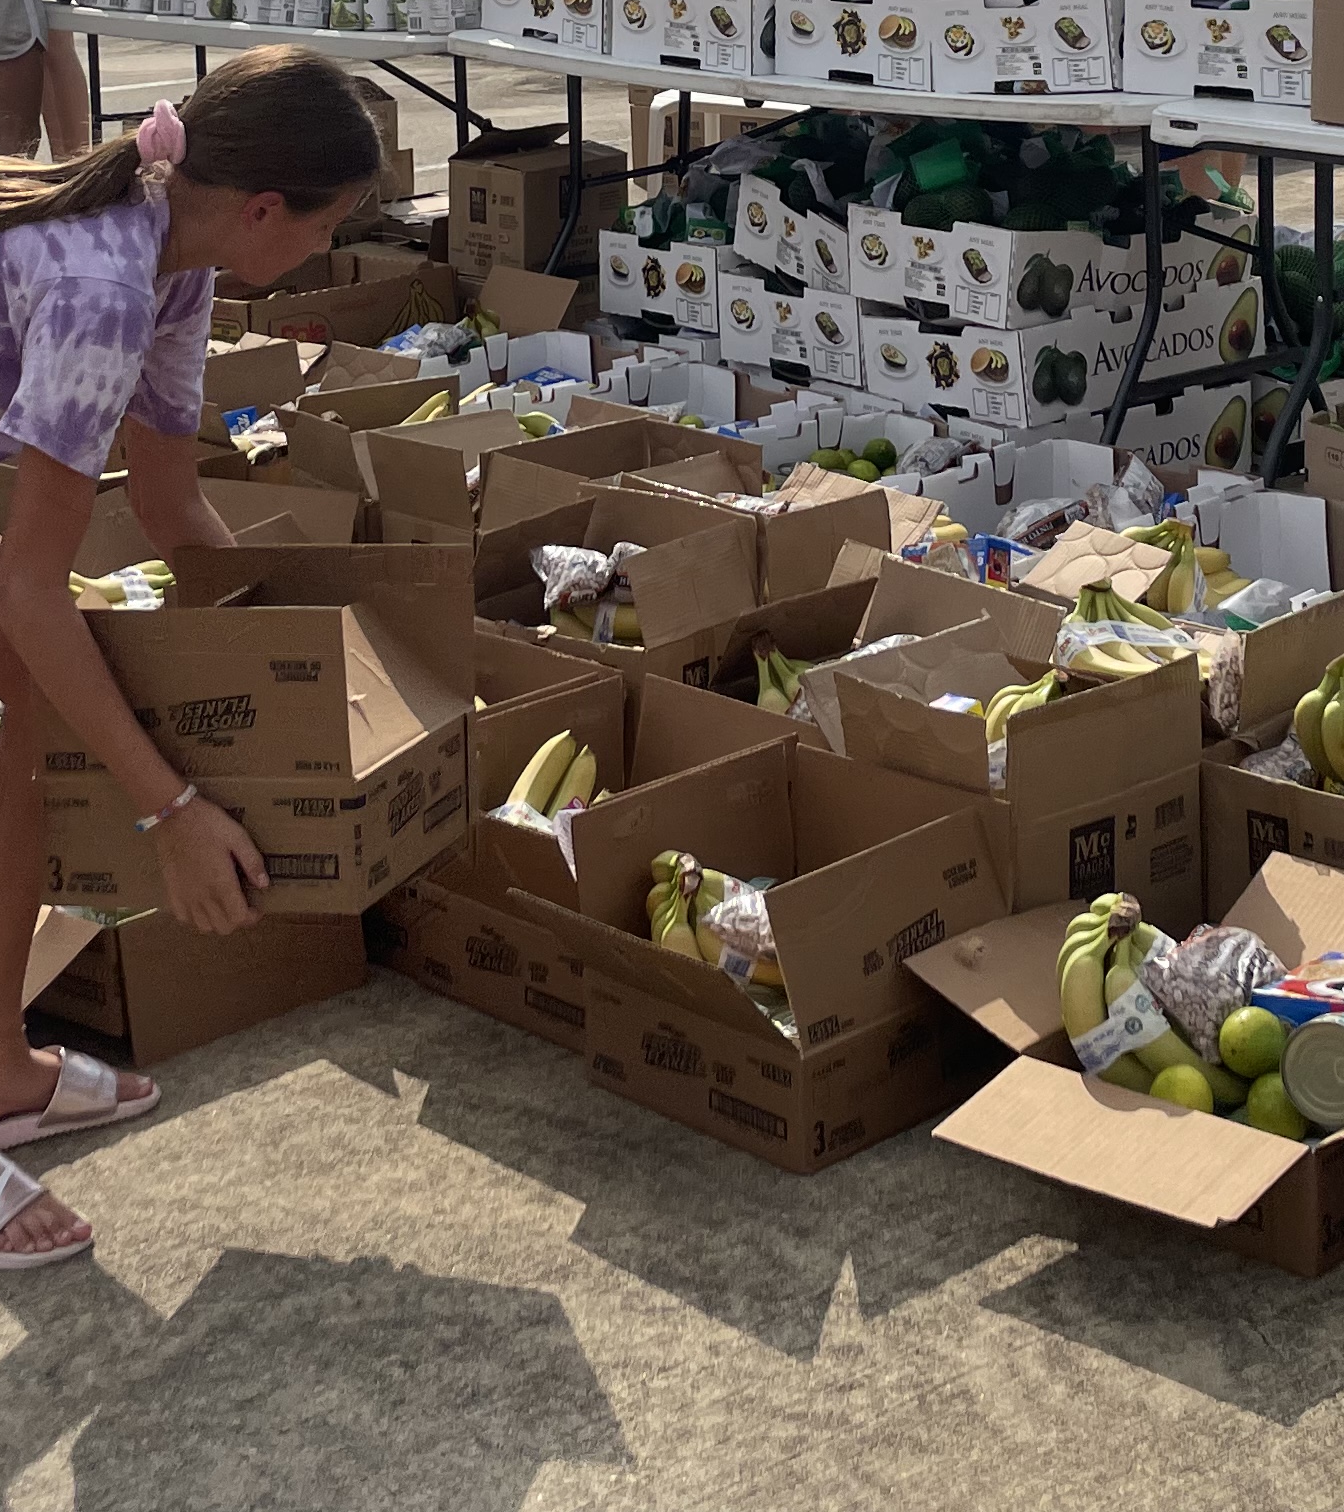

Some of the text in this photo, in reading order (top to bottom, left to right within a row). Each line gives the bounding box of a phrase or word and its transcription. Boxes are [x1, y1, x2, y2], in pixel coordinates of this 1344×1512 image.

[1076, 259, 1204, 295] AVOCDOS
[177, 707, 256, 734] FROSTED
[185, 694, 251, 719] FLAKES
[47, 855, 64, 894] 3
